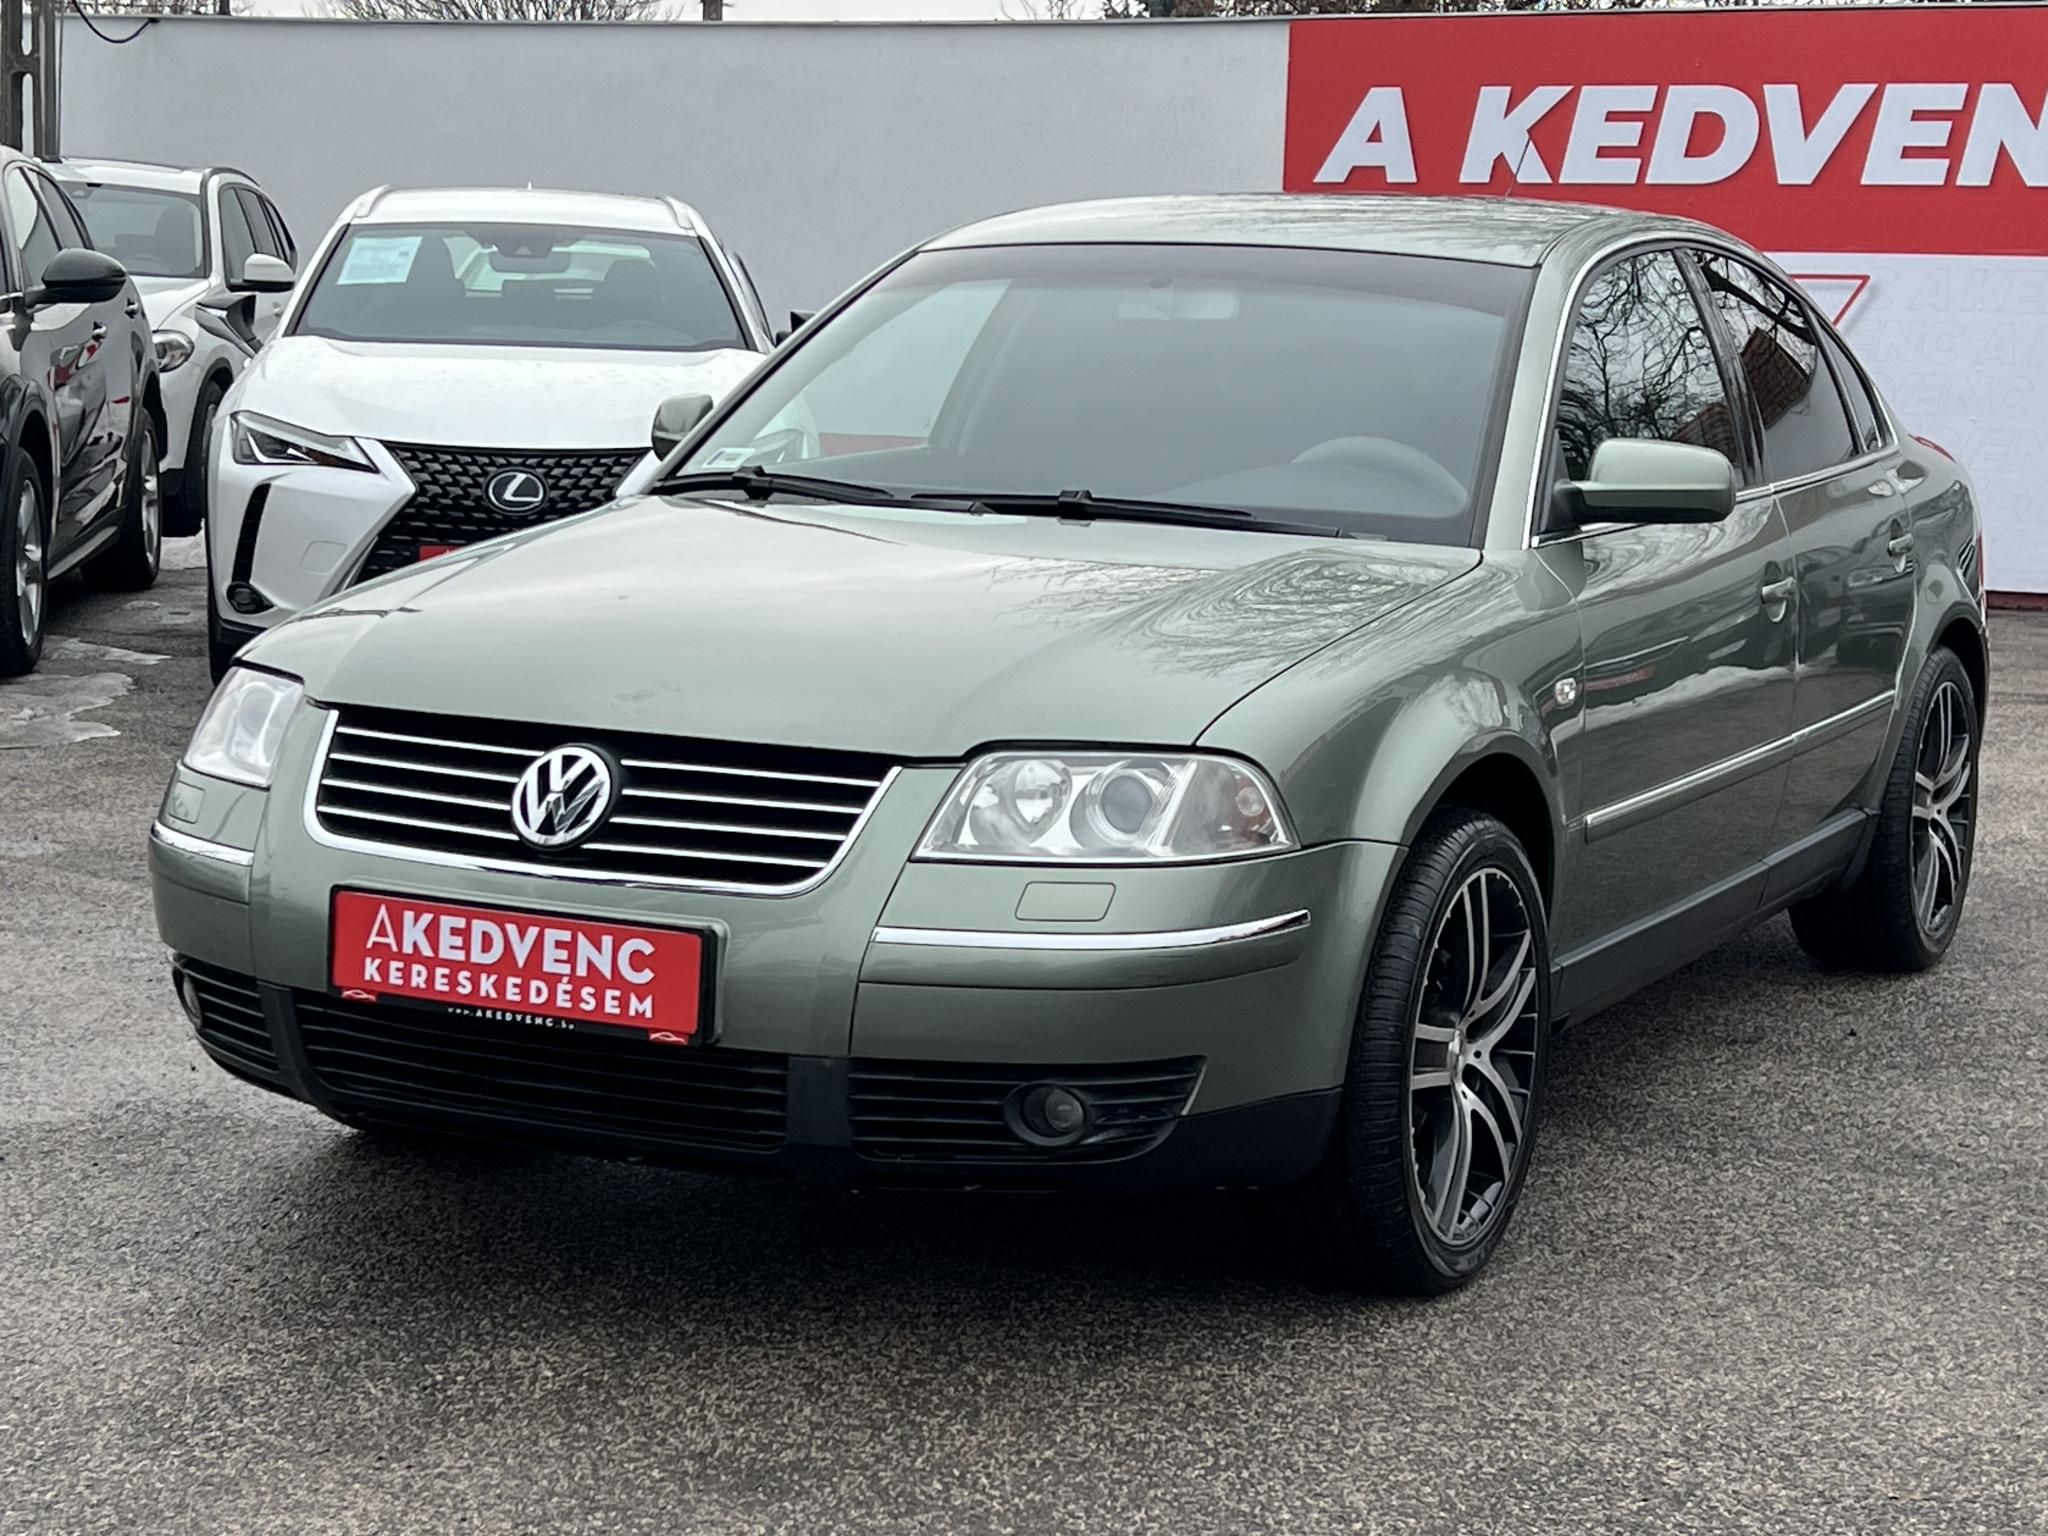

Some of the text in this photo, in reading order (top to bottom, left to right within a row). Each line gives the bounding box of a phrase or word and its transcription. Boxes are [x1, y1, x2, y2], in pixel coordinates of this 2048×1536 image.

[1312, 82, 2048, 188] A KEDVEN
[365, 903, 656, 986] AKEDVENC
[363, 956, 654, 1020] KERESKEDÉSEM
